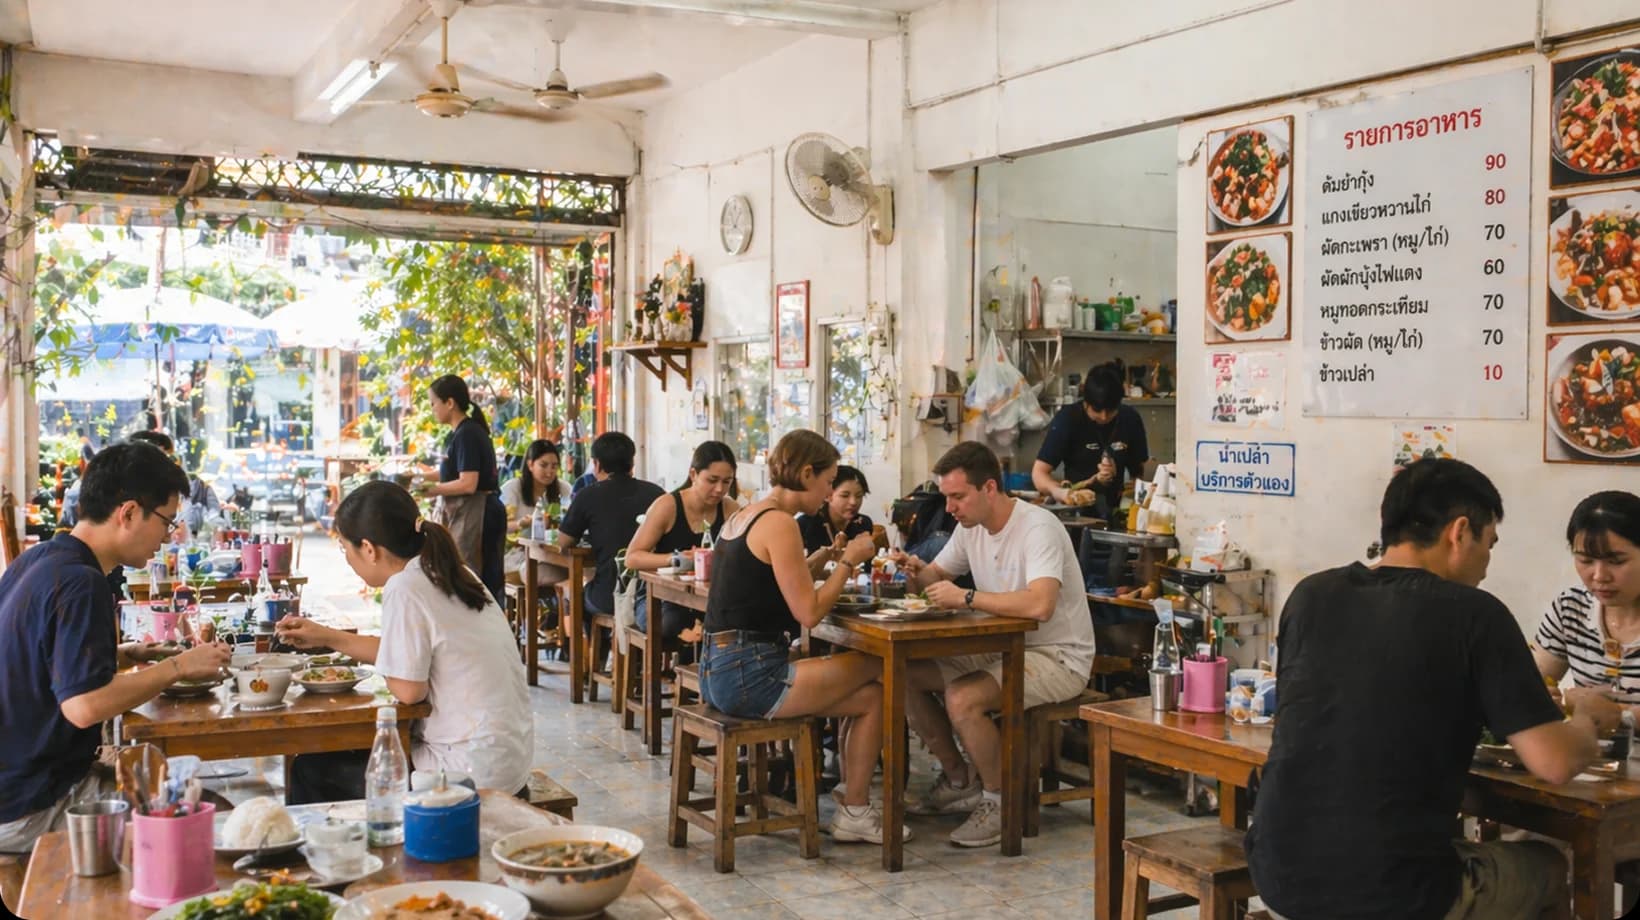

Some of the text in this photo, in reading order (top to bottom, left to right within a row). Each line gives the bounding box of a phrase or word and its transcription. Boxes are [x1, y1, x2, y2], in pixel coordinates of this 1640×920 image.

[1344, 108, 1482, 150] รายการอาหาร
[1485, 153, 1506, 171] 90
[1485, 189, 1505, 205] 80
[1322, 192, 1431, 225] แกงเขียวหวานไก่
[1484, 223, 1505, 241] 70
[1321, 238, 1388, 256] ผัดกะเพรา
[1484, 258, 1505, 275] 60
[1320, 295, 1429, 324] หมูทอดกระเทียม
[1483, 293, 1504, 310] 70
[1319, 331, 1363, 350] ข้าวผัด
[1482, 329, 1504, 345] 70
[1319, 363, 1375, 382] ข้าวเปล่า
[1484, 364, 1503, 380] 10
